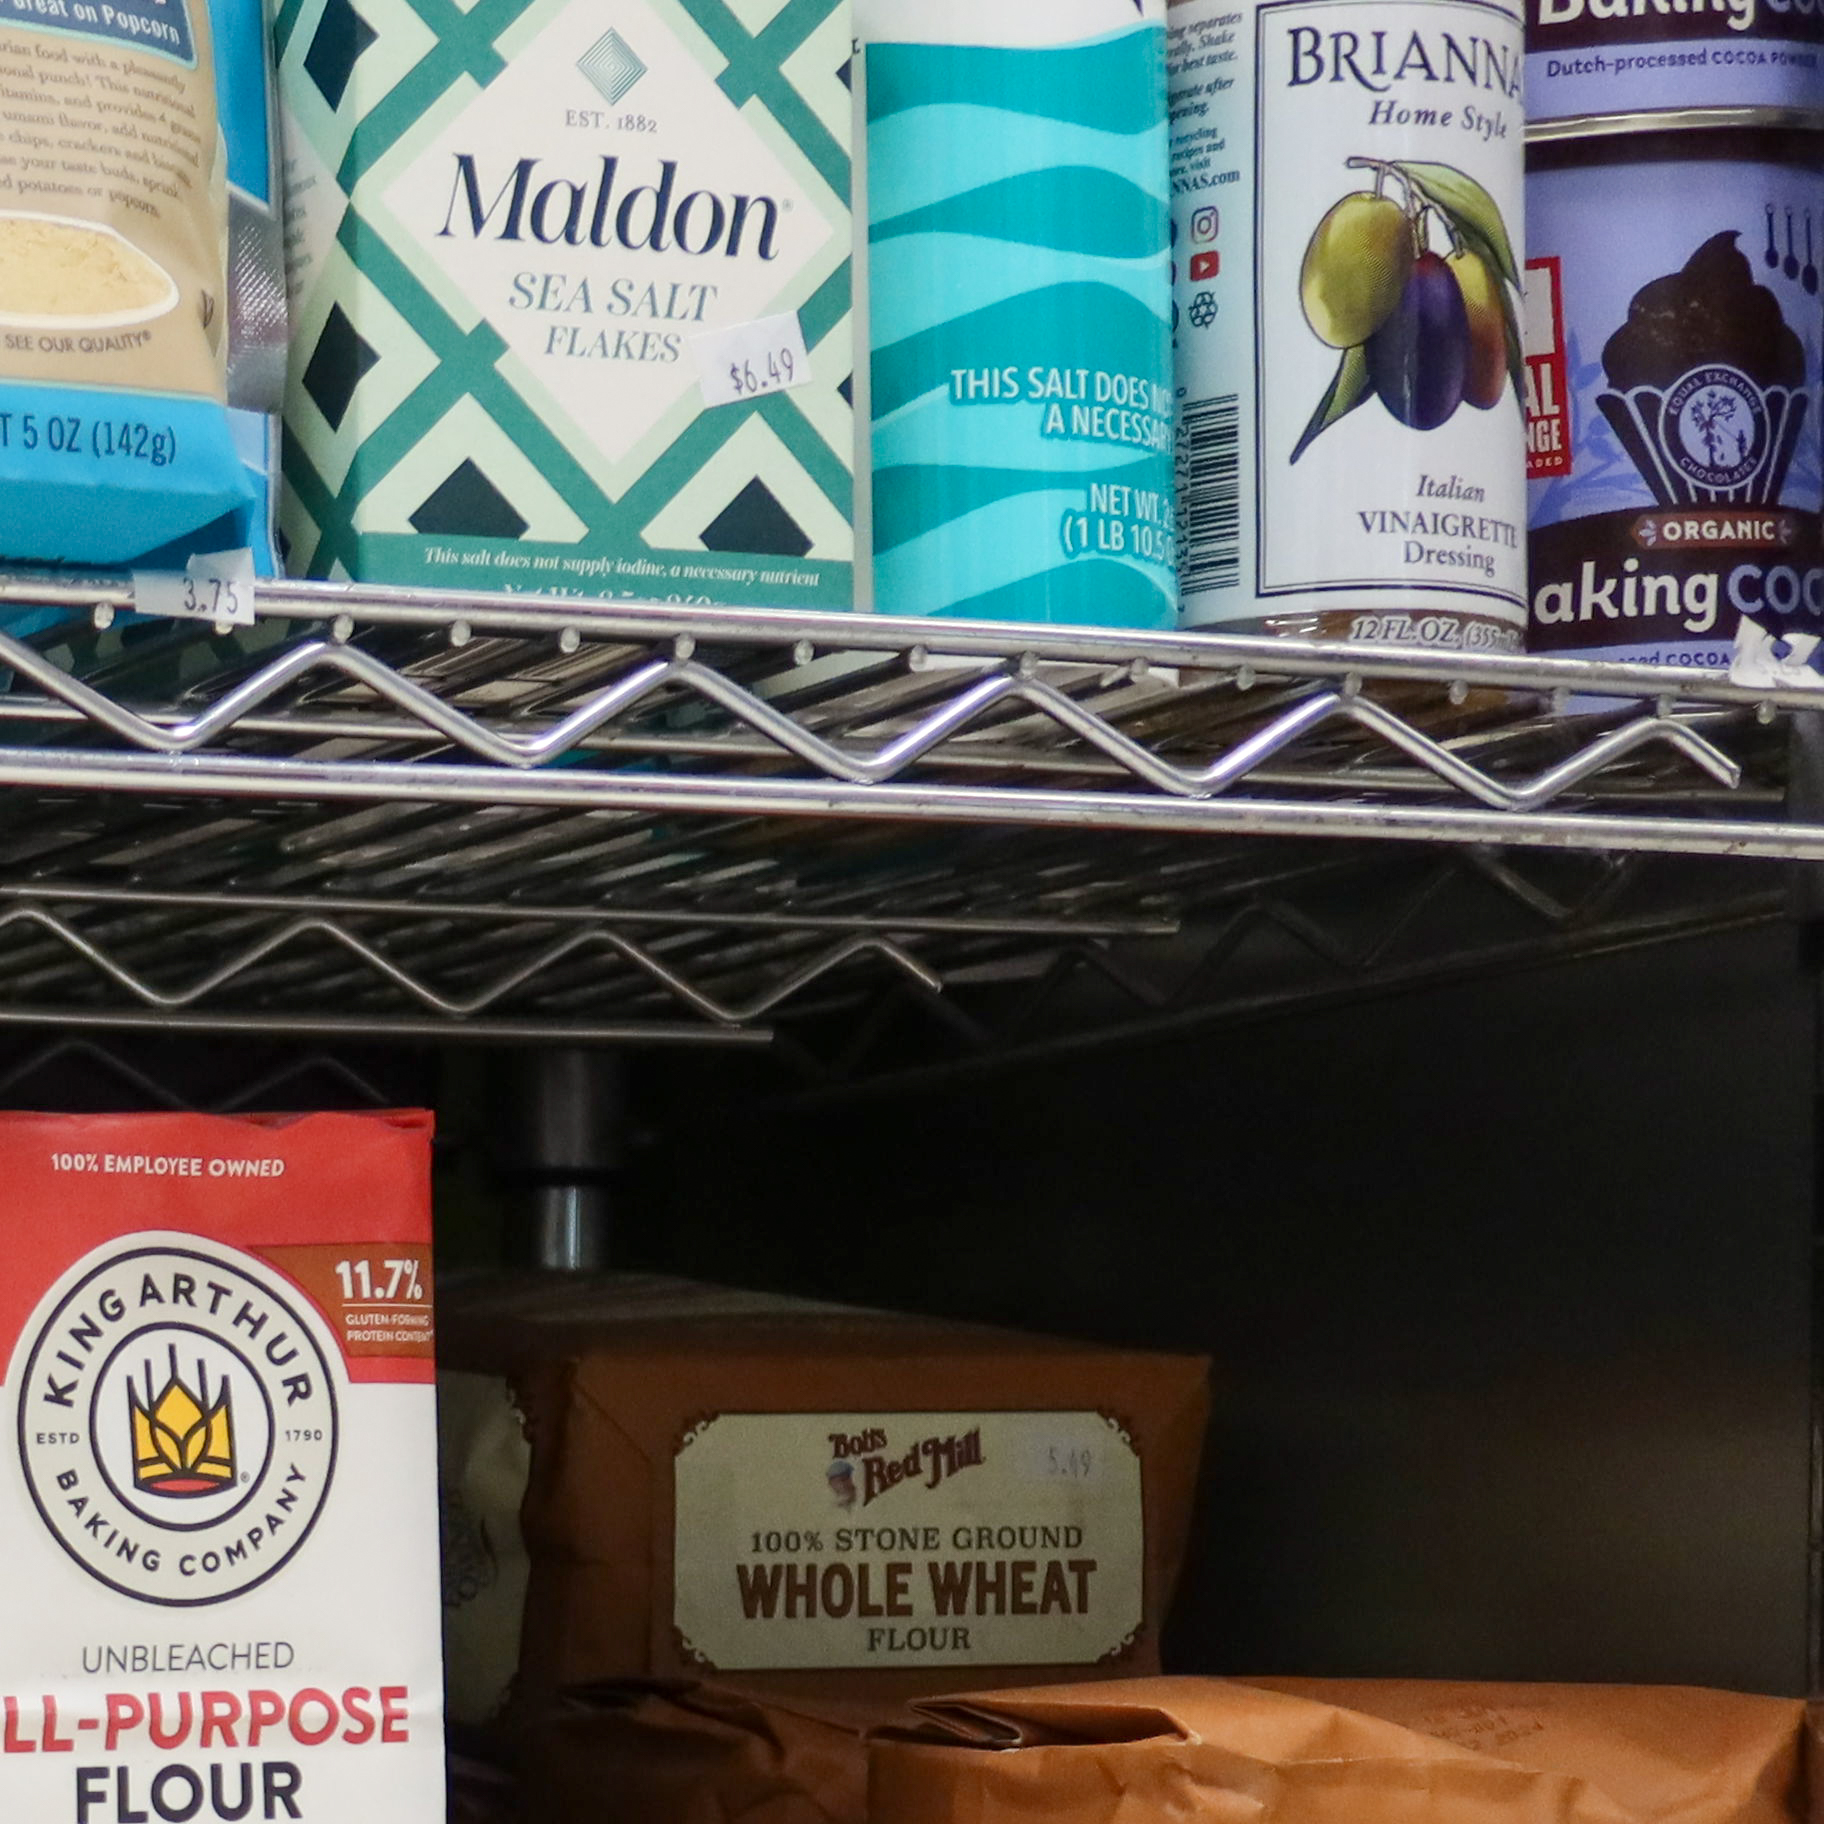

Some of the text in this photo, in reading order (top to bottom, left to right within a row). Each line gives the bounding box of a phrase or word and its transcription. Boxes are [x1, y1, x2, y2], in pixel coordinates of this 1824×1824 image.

[565, 110, 657, 134] EST. 1882
[1369, 101, 1507, 139] Home Style
[508, 272, 717, 323] SEA SALT
[544, 325, 681, 364] FLAKES
[729, 351, 796, 393] $6.49
[951, 367, 1149, 410] THIS SALT DOES
[24, 415, 38, 450] 5
[48, 417, 81, 453] OZ
[92, 420, 176, 466] (142g)
[1416, 475, 1485, 503] Italian
[1358, 510, 1518, 549] VINAIGRETTE
[1662, 520, 1776, 541] ORGANIC
[424, 546, 819, 586] This salt does not supply iodine, a necessary nutrient
[1403, 541, 1496, 576] Dressing
[183, 577, 238, 614] 3.75
[51, 1153, 284, 1178] 100% EMPLOYEE OWNED
[334, 1259, 422, 1300] 11.7%
[44, 1274, 314, 1408] KING ARTHUR
[36, 1432, 80, 1444] ESTD
[284, 1429, 323, 1441] 1790
[55, 1462, 308, 1577] BAKING COMPANY
[751, 1525, 1084, 1553] 100% STONE GROUND
[736, 1559, 1097, 1619] WHOLE WHEAT
[81, 1641, 295, 1675] UNBLEACHED
[866, 1627, 971, 1651] FLOUR
